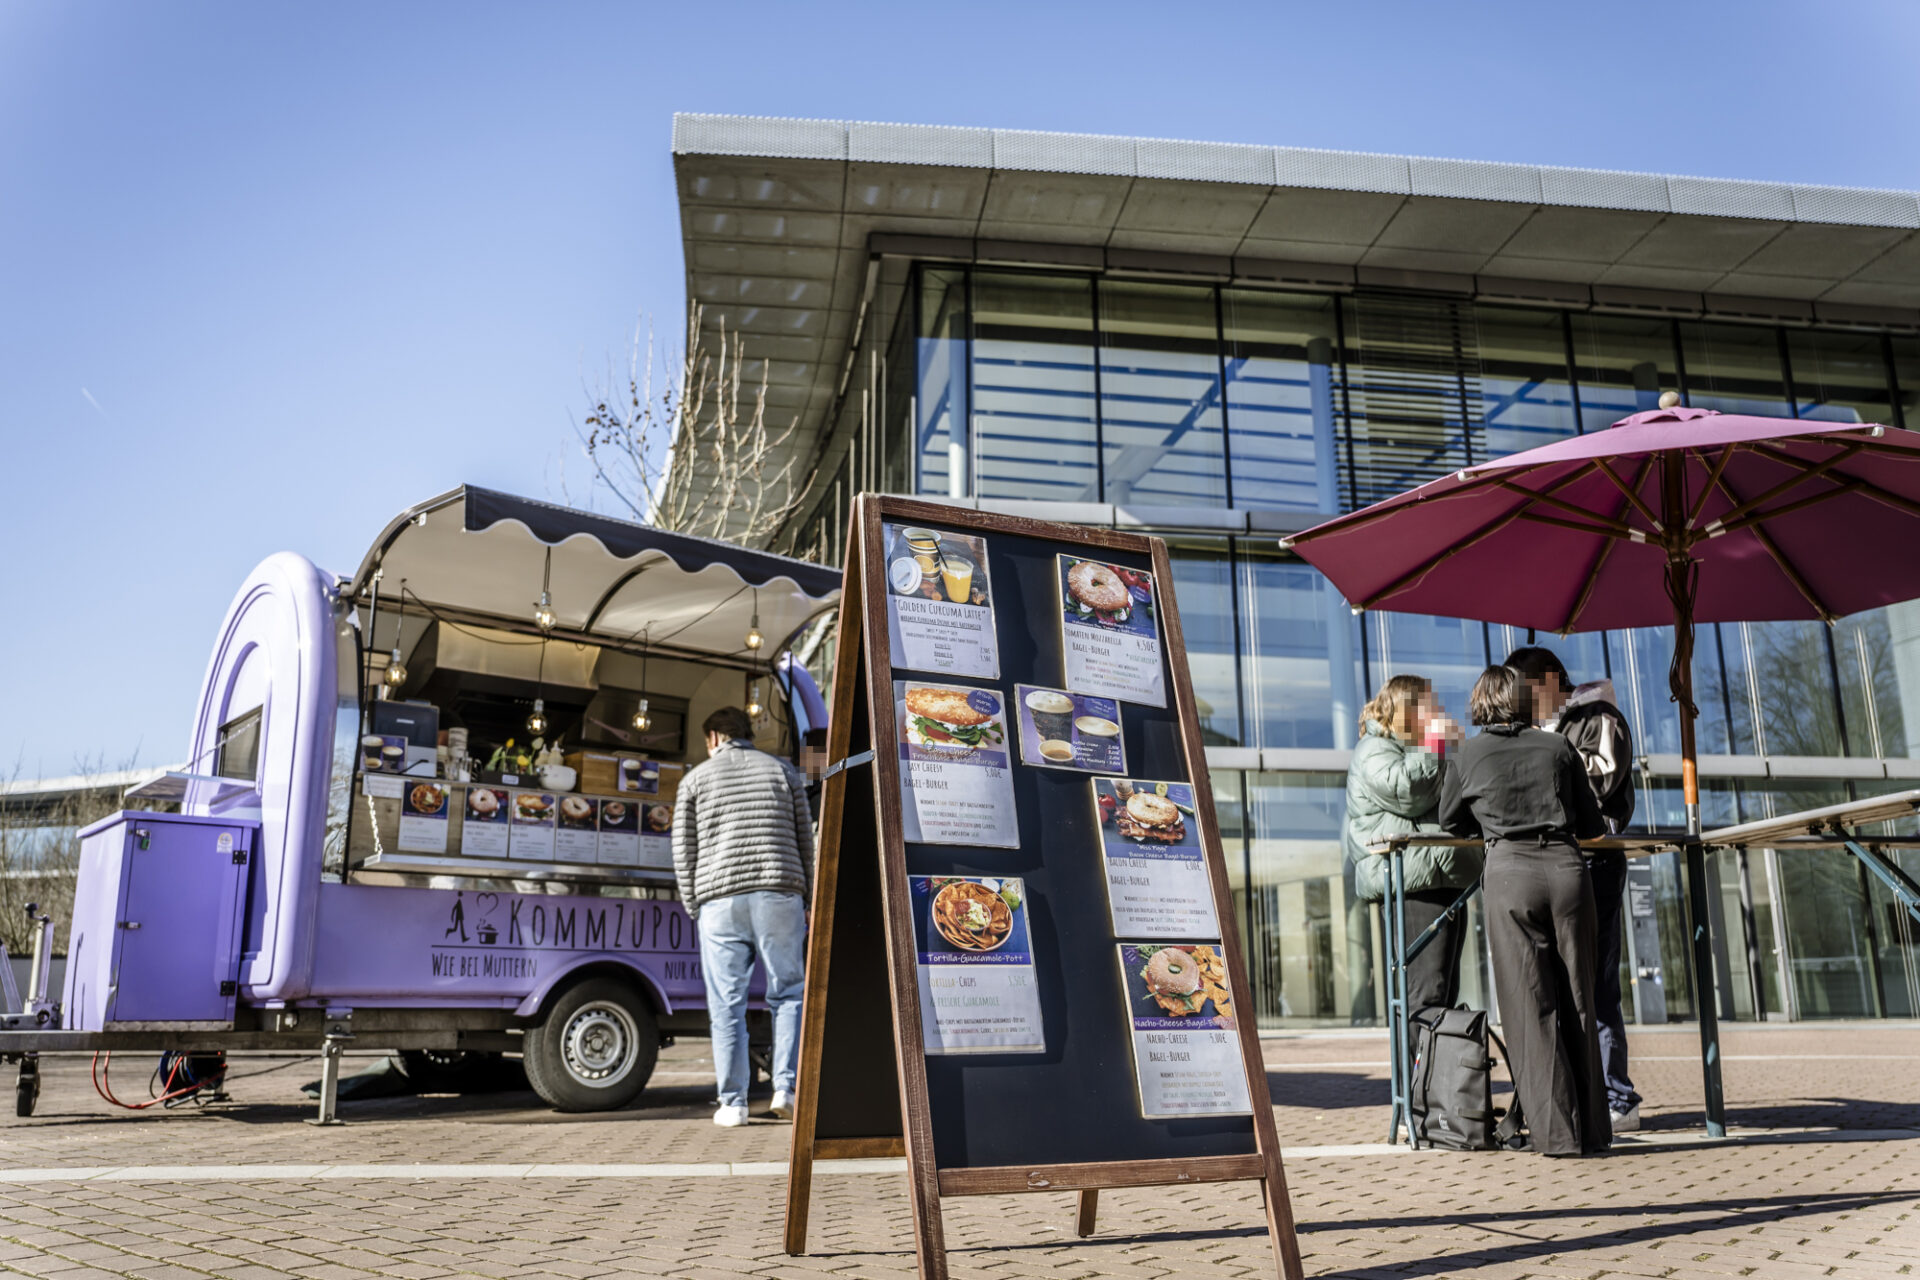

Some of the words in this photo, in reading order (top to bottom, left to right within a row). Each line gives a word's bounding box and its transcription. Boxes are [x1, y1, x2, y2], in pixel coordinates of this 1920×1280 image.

[928, 603, 962, 618] CURCUMA
[1064, 627, 1090, 640] TOMATEN
[1091, 632, 1122, 646] MOZZARELLA
[1072, 642, 1111, 657] BAGEL-BURGER
[907, 762, 921, 772] EASY
[922, 762, 943, 773] CHEESY
[903, 778, 949, 790] BAGEL-BURGER
[1109, 858, 1128, 868] BACON
[1128, 858, 1148, 869] CHEESE
[1110, 874, 1150, 886] BAGEL-BURGER
[927, 953, 1024, 964] Tortilla-Guacamole-Pott
[431, 953, 455, 977] WIE
[460, 955, 478, 977] BEI
[483, 954, 537, 979] MUTTERN
[664, 961, 687, 980] NUR
[936, 997, 960, 1007] FRISCHE
[963, 996, 1000, 1007] GUACAMOLE
[1146, 1033, 1188, 1044] NACHO-CHEESE
[1149, 1051, 1191, 1062] BAGEL-BURGER
